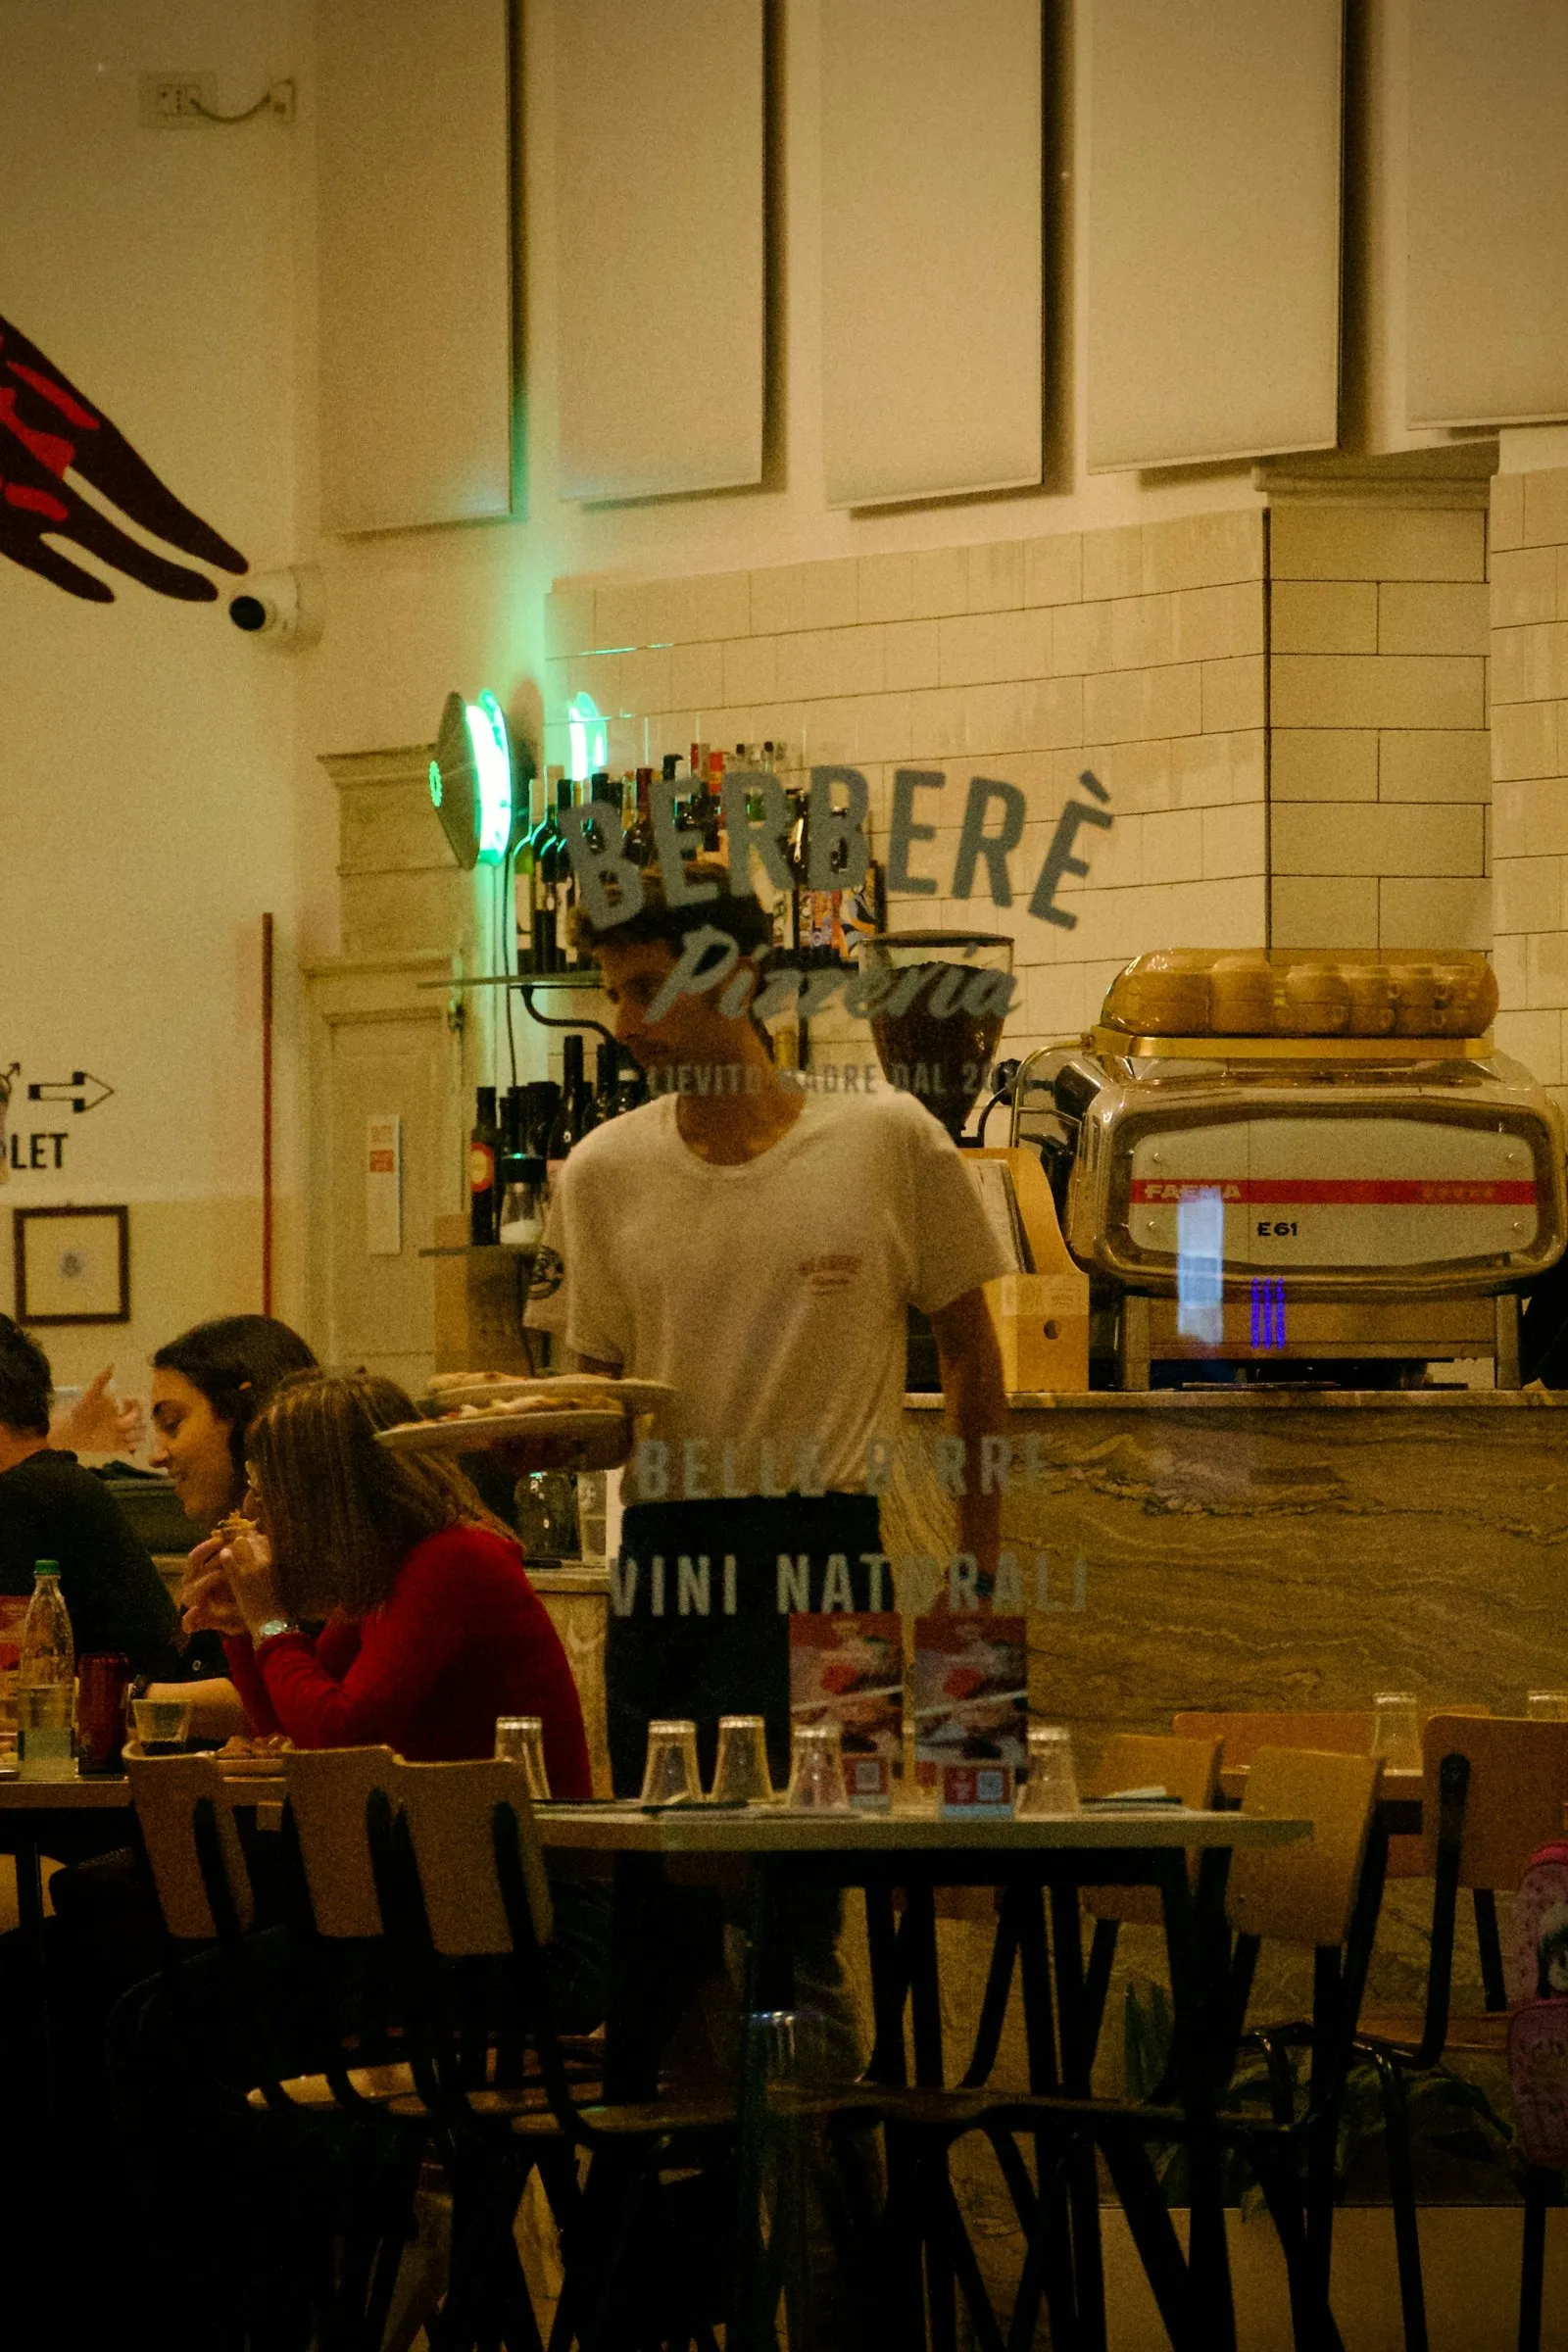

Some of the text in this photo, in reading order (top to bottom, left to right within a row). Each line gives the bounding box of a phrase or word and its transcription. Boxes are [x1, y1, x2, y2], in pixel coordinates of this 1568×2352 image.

[559, 764, 1114, 931] BERBERÈ
[642, 924, 1022, 1024] Pizzeria
[780, 1062, 875, 1095] ADRE
[893, 1062, 948, 1094] DAL
[1144, 1184, 1241, 1200] FAEMA
[637, 1432, 1054, 1499] BELLE BRRE
[609, 1552, 1087, 1617] VINI NATURALI
